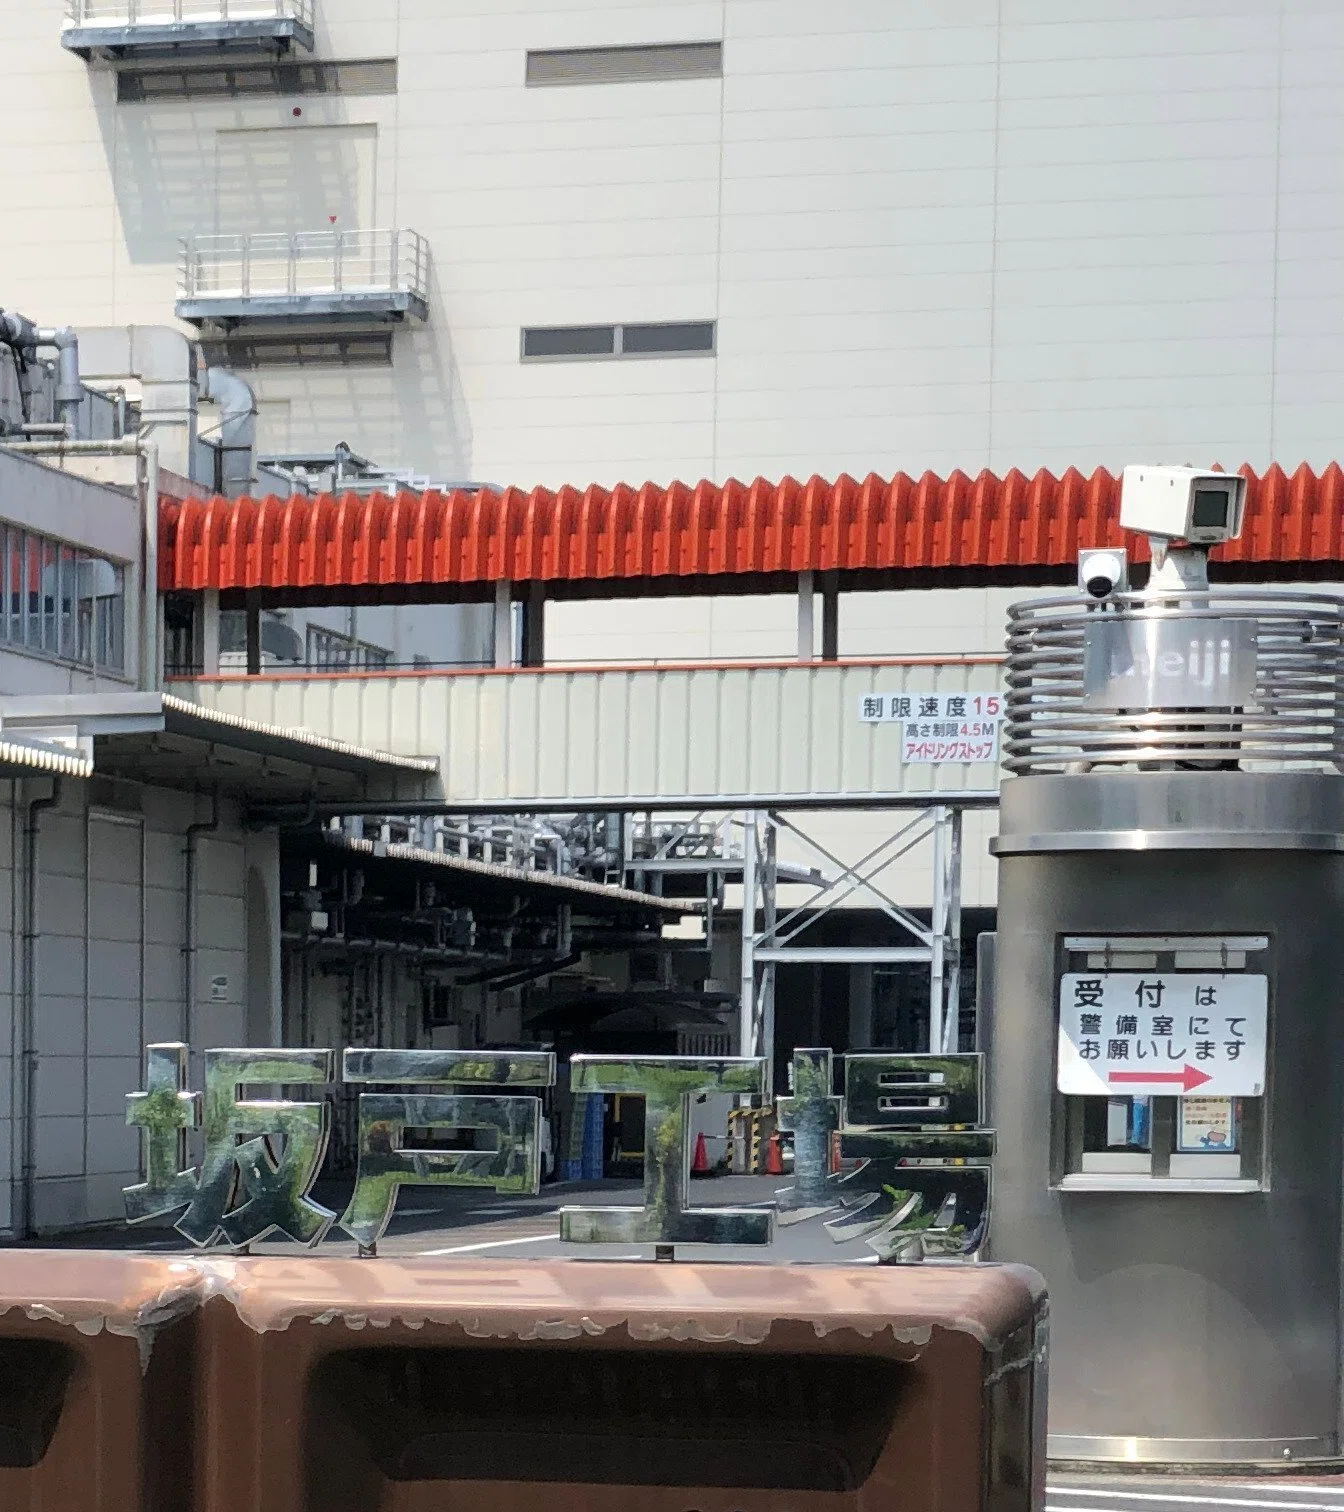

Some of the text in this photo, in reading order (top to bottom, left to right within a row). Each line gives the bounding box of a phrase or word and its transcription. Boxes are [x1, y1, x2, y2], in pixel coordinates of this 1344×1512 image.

[905, 741, 994, 760] アイドリングストップ
[1073, 979, 1218, 1009] 受付は
[1079, 1013, 1247, 1037] 警備室にて
[1078, 1038, 1246, 1061] お願いします
[124, 1042, 996, 1260] 坂戸工場
